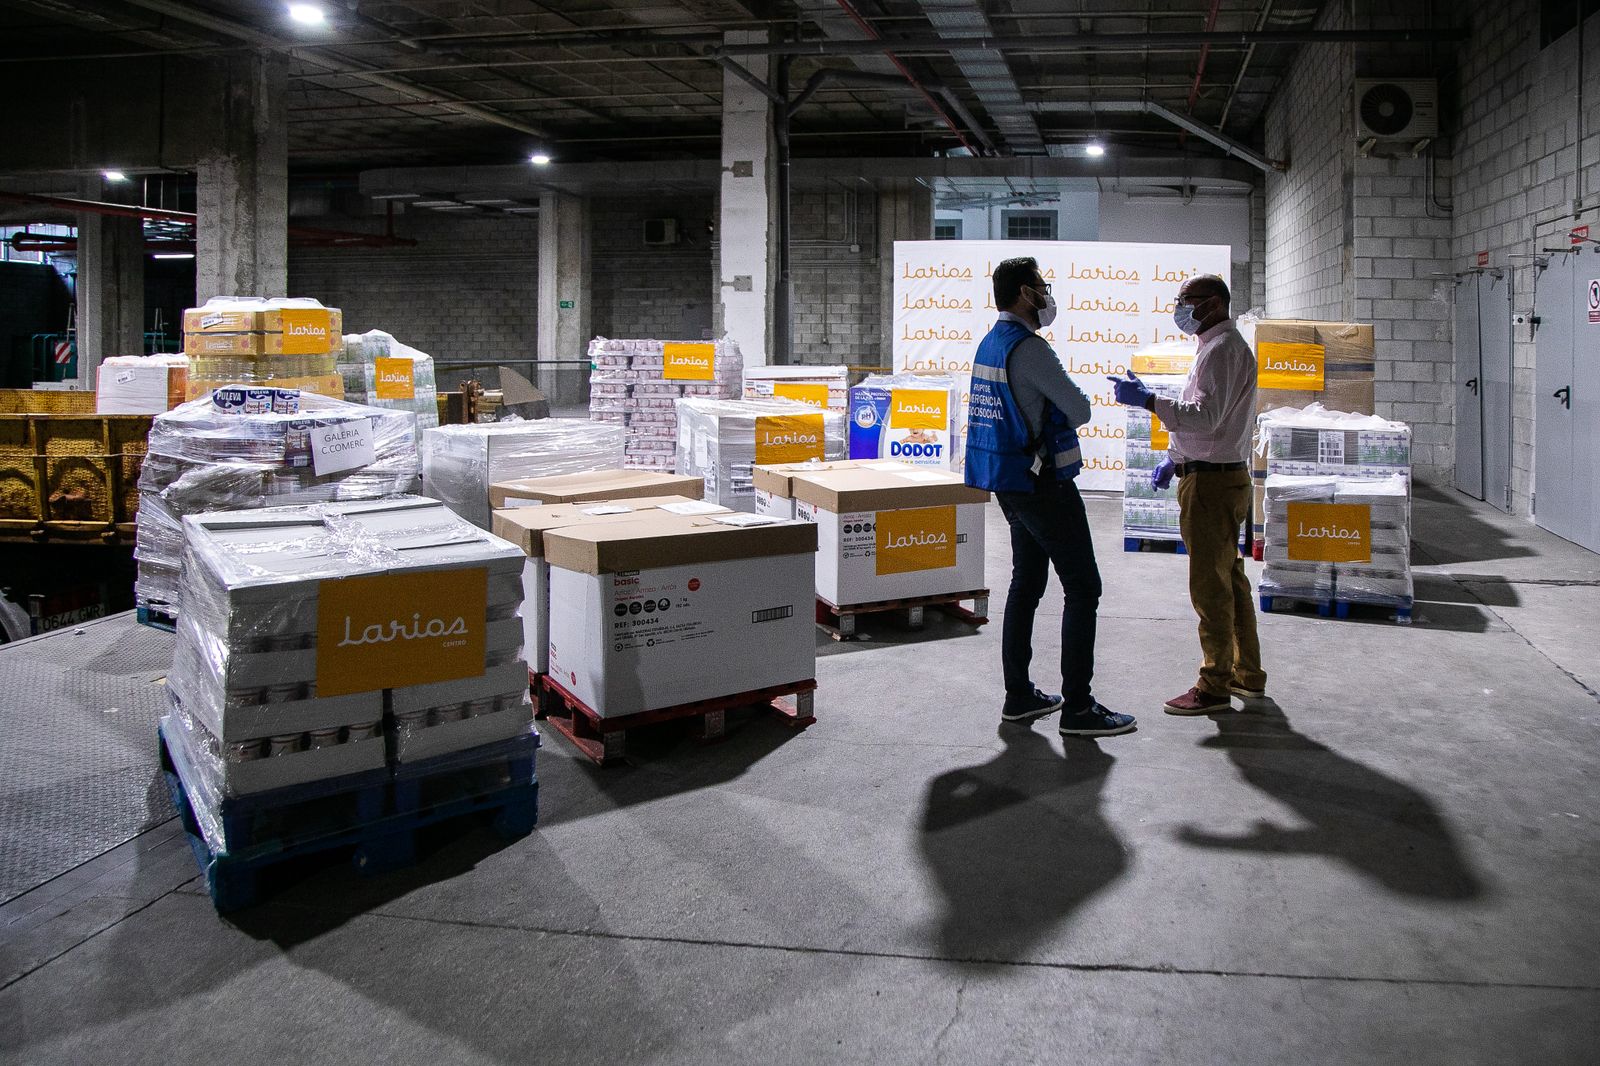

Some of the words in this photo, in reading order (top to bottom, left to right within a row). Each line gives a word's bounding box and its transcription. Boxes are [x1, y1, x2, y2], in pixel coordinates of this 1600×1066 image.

[902, 262, 973, 279] Larios
[1067, 262, 1140, 281] Larios
[902, 293, 972, 310] Larios
[1067, 294, 1140, 312] Larios
[288, 322, 325, 336] Larios
[901, 323, 972, 341] Larios
[1067, 325, 1140, 345] Larios
[670, 354, 708, 366] Larios
[902, 355, 972, 371] Larios
[1069, 357, 1126, 375] Lario
[1264, 357, 1316, 372] Larios
[380, 370, 410, 382] Larios
[216, 392, 242, 401] PULEVA
[970, 394, 1002, 407] ERGENCIA
[897, 402, 941, 414] Larios
[324, 428, 360, 443] GALERIA
[764, 432, 816, 446] Larios
[1078, 424, 1125, 439] ario
[322, 438, 364, 455] C.COMERC
[890, 441, 942, 457] DODOT
[1296, 522, 1360, 538] Larios
[884, 530, 947, 548] Larios
[614, 577, 640, 586] basic
[43, 612, 74, 630] 0644
[632, 618, 658, 626] 300434
[338, 613, 468, 646] Larios
[442, 640, 467, 648] CENTRO
